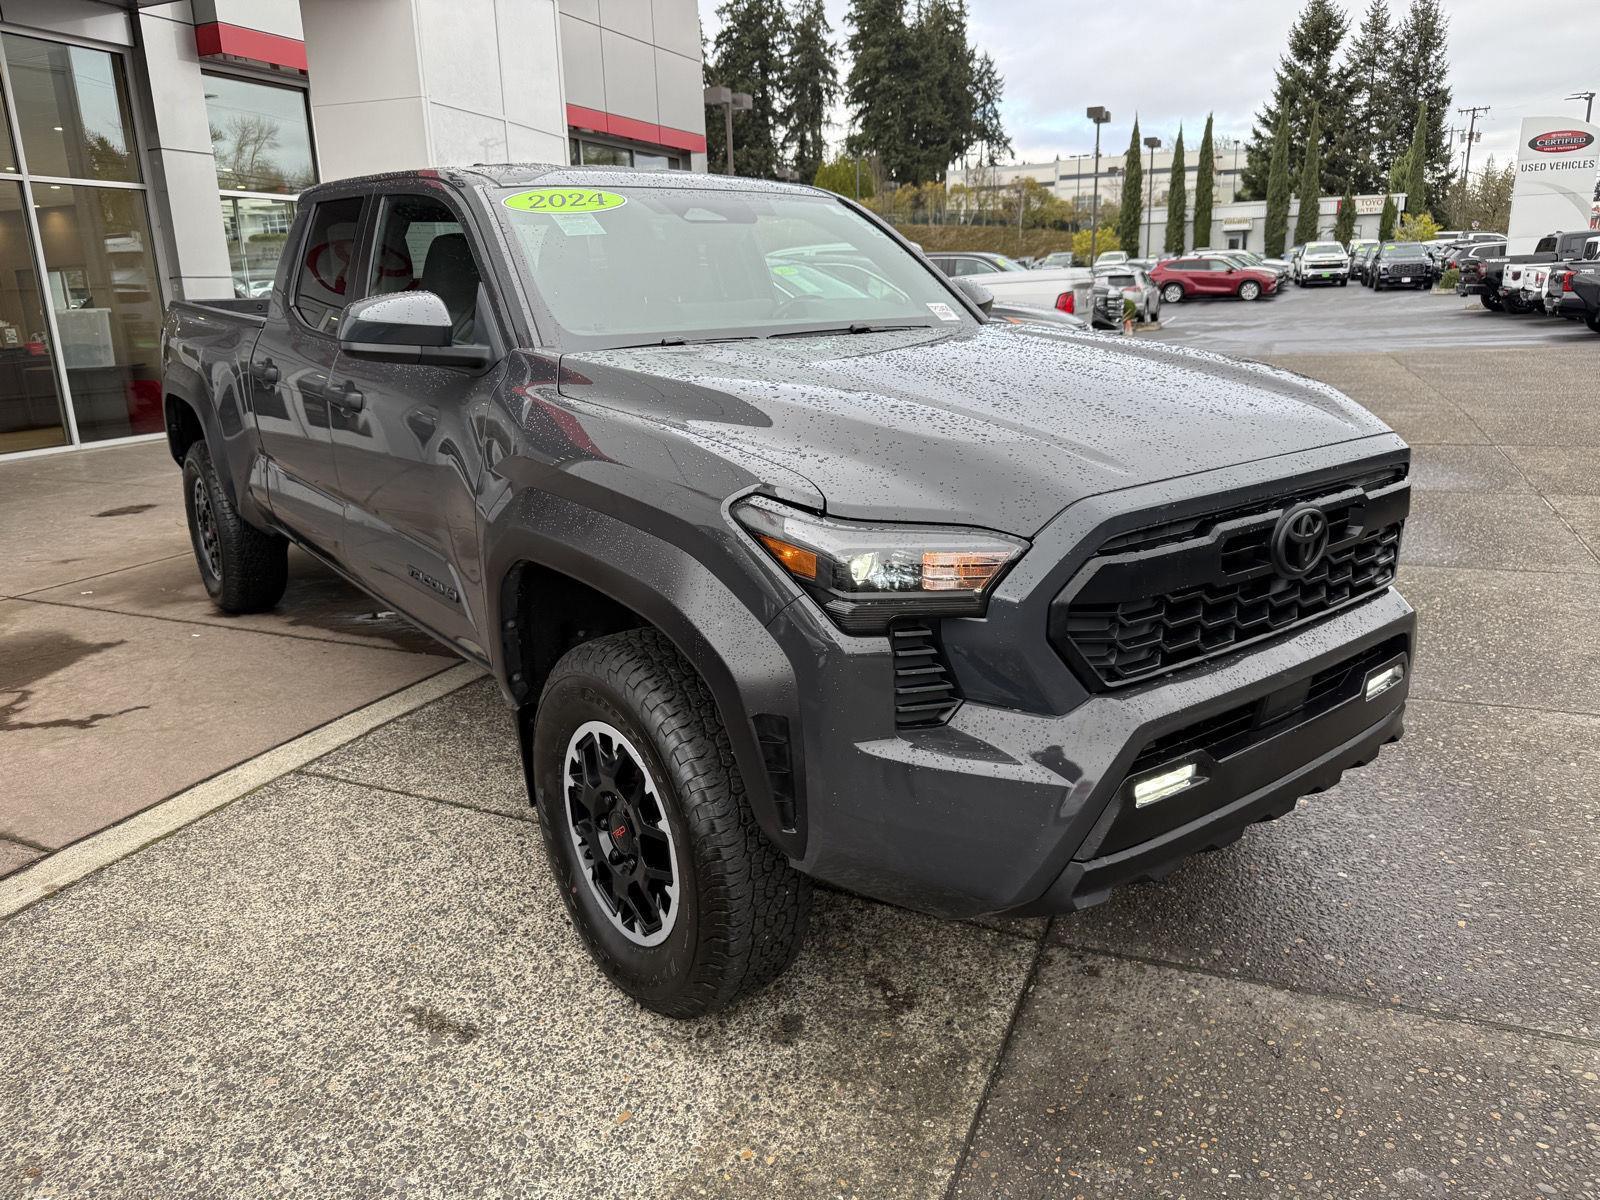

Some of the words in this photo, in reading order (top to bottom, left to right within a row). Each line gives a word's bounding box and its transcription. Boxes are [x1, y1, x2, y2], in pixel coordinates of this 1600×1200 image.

[1536, 137, 1586, 146] CERTIFIED
[1521, 163, 1547, 172] USED
[1549, 160, 1595, 171] VEHICLES
[528, 192, 607, 209] 2024
